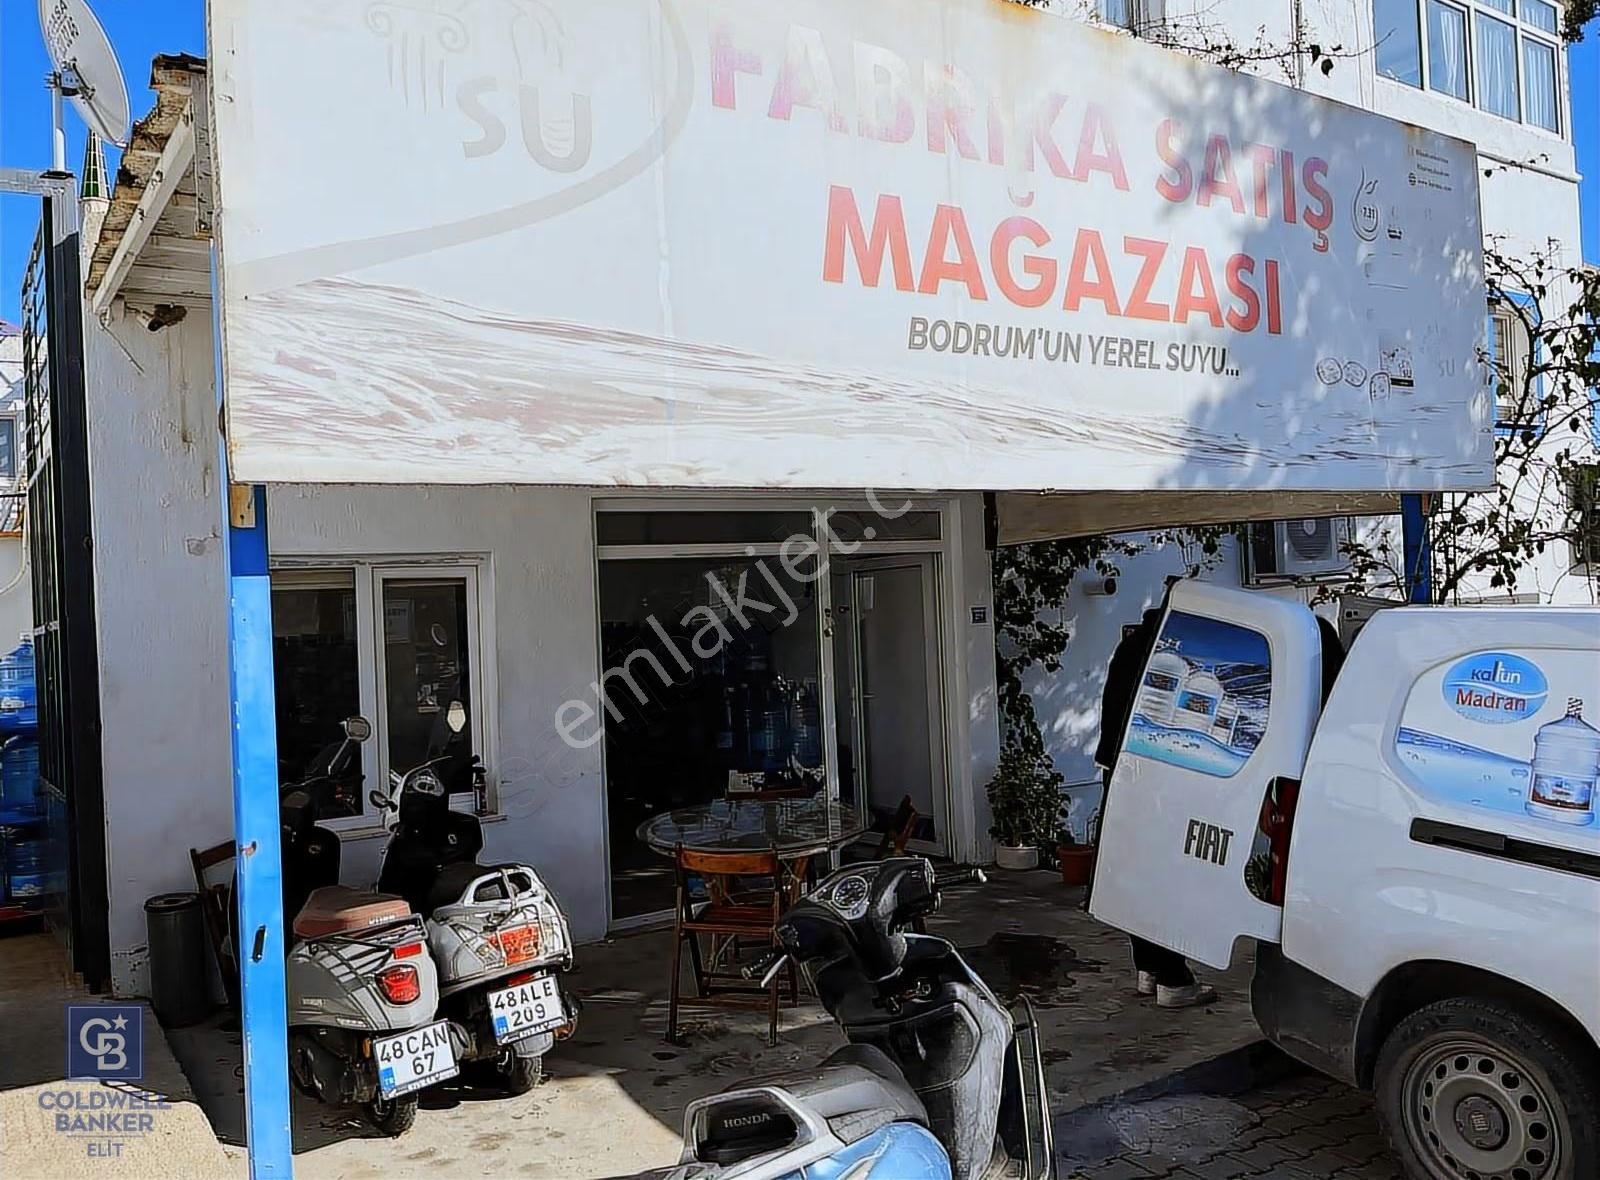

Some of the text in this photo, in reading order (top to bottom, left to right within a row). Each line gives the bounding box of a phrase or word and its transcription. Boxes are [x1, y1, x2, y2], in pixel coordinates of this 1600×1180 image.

[1154, 118, 1335, 253] SATIŞ
[822, 184, 1282, 335] MAĞAZASI
[907, 316, 1241, 377] BODRUM'UN YEREL SUYU...
[1456, 688, 1527, 713] Madran
[1184, 818, 1235, 867] FIAT
[511, 1003, 546, 1027] 209
[412, 1051, 435, 1076] 67
[723, 1112, 771, 1129] HONDA
